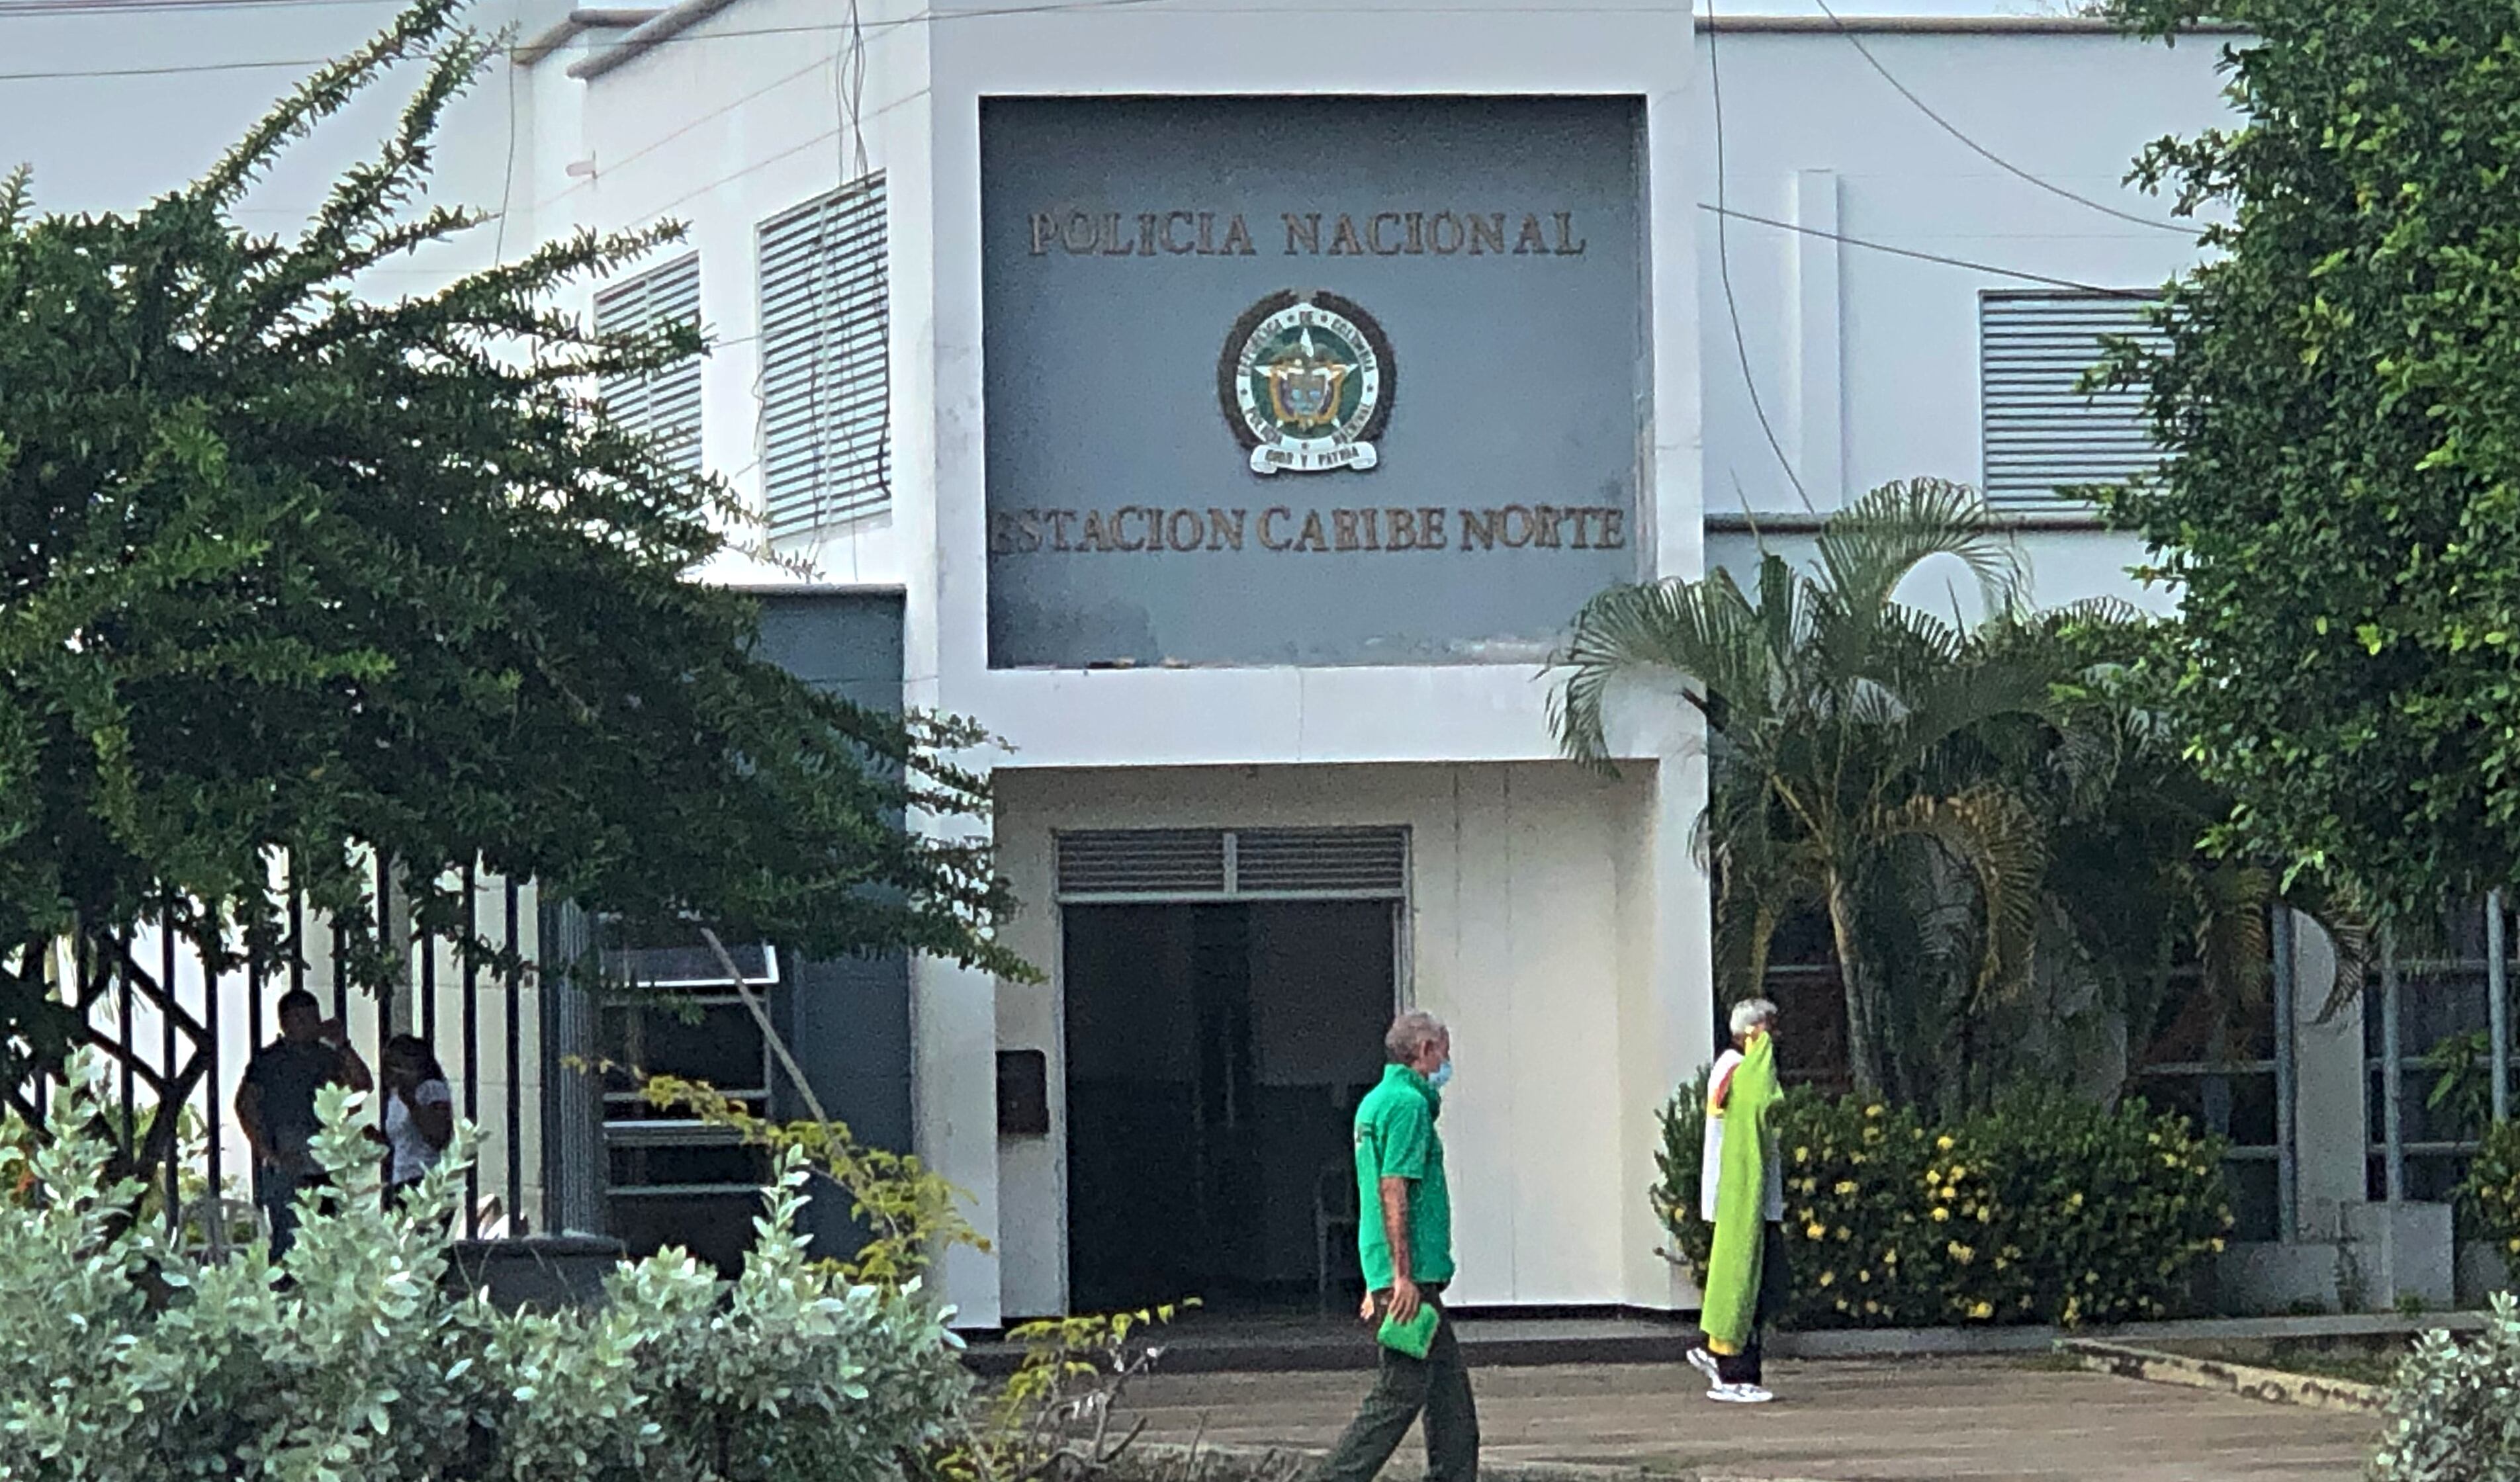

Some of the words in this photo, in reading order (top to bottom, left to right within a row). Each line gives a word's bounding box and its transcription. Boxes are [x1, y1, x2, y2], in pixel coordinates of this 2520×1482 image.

[1028, 210, 1257, 256] POLICIA
[1280, 210, 1586, 255] NACIONAL
[991, 505, 1247, 555] ESTACION
[1259, 506, 1448, 552] CARIBE
[1457, 504, 1625, 552] NORTE
